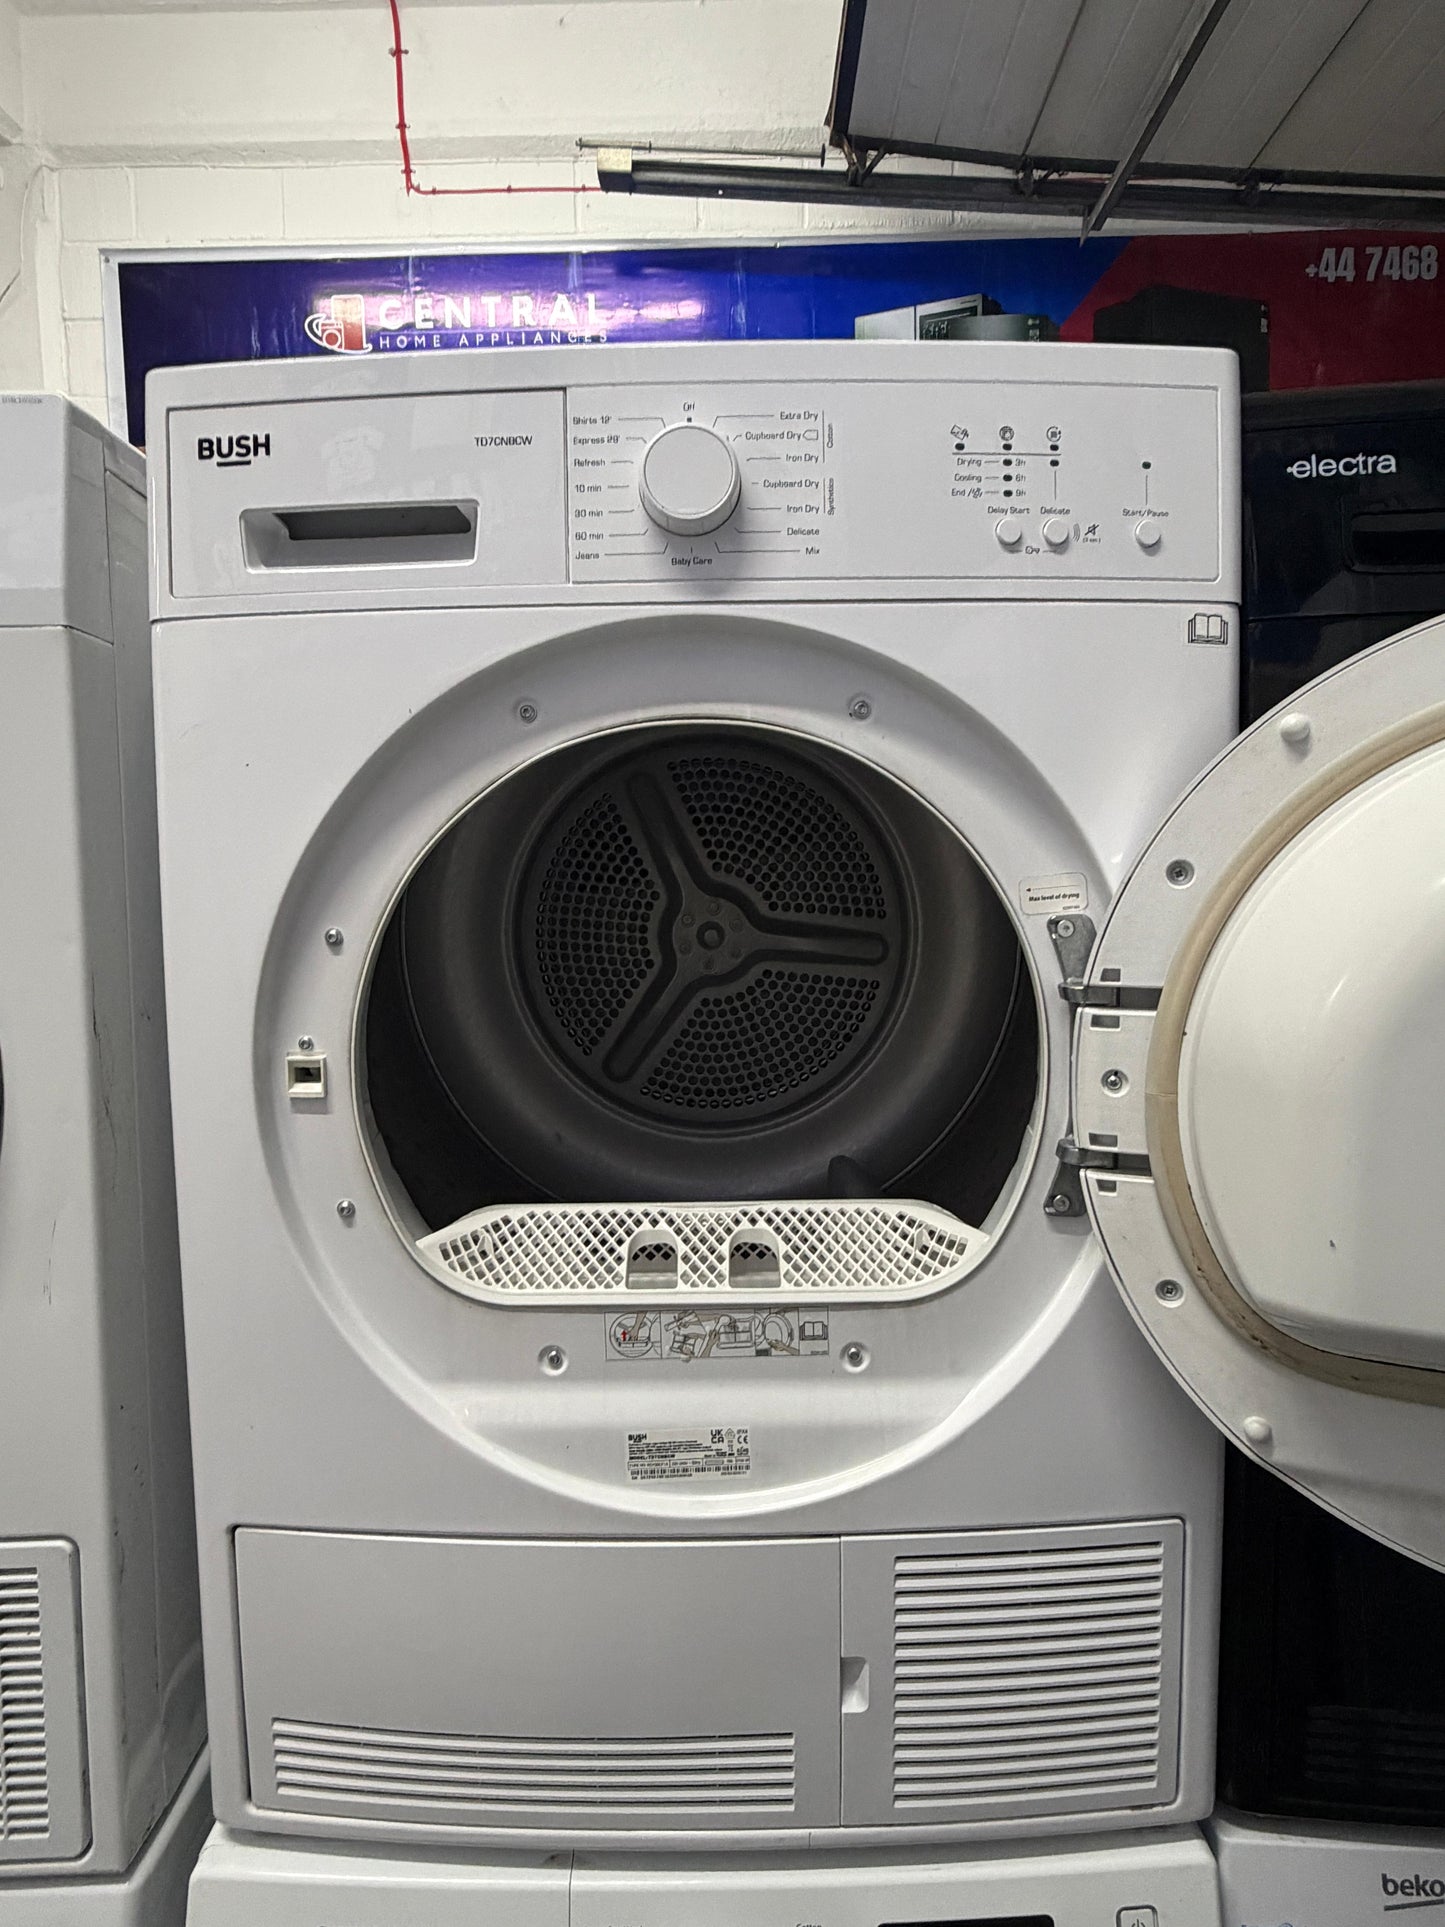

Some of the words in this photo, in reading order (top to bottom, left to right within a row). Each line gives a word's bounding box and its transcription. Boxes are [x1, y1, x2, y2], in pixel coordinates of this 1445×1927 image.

[1305, 247, 1356, 283] +44
[1365, 245, 1438, 281] 7468
[379, 294, 609, 330] CENTRAL
[380, 334, 441, 350] HOME
[459, 330, 608, 348] APPLIANCES
[683, 401, 696, 412] Off
[573, 416, 598, 425] Shirts
[780, 411, 801, 421] Extra
[803, 411, 819, 422] Dry
[573, 436, 605, 446] Express
[745, 431, 785, 442] Cupboard
[786, 431, 802, 441] Dry
[198, 433, 270, 460] BUSH
[574, 458, 606, 467] Refresh
[786, 454, 803, 463] Iron
[804, 453, 819, 464] Dry
[957, 457, 982, 467] Drying
[1291, 452, 1398, 479] electra
[954, 473, 982, 484] Cooling
[575, 484, 585, 493] 10
[587, 485, 602, 493] min
[763, 479, 803, 490] Cupboard
[804, 479, 820, 490] Dry
[588, 510, 604, 518] min
[786, 505, 803, 514] Iron
[804, 504, 820, 515] Dry
[987, 506, 1009, 516] Delay
[1009, 506, 1030, 515] Start
[1040, 506, 1071, 515] Delicate
[575, 531, 587, 541] 60
[589, 533, 604, 541] min
[786, 527, 820, 536] Delicate
[805, 546, 820, 555] Mix
[575, 552, 600, 561] Jeans
[671, 557, 692, 567] Baby
[692, 556, 713, 565] Care
[710, 1429, 724, 1437] UK
[710, 1436, 725, 1444] CA
[1381, 1873, 1445, 1898] beko
